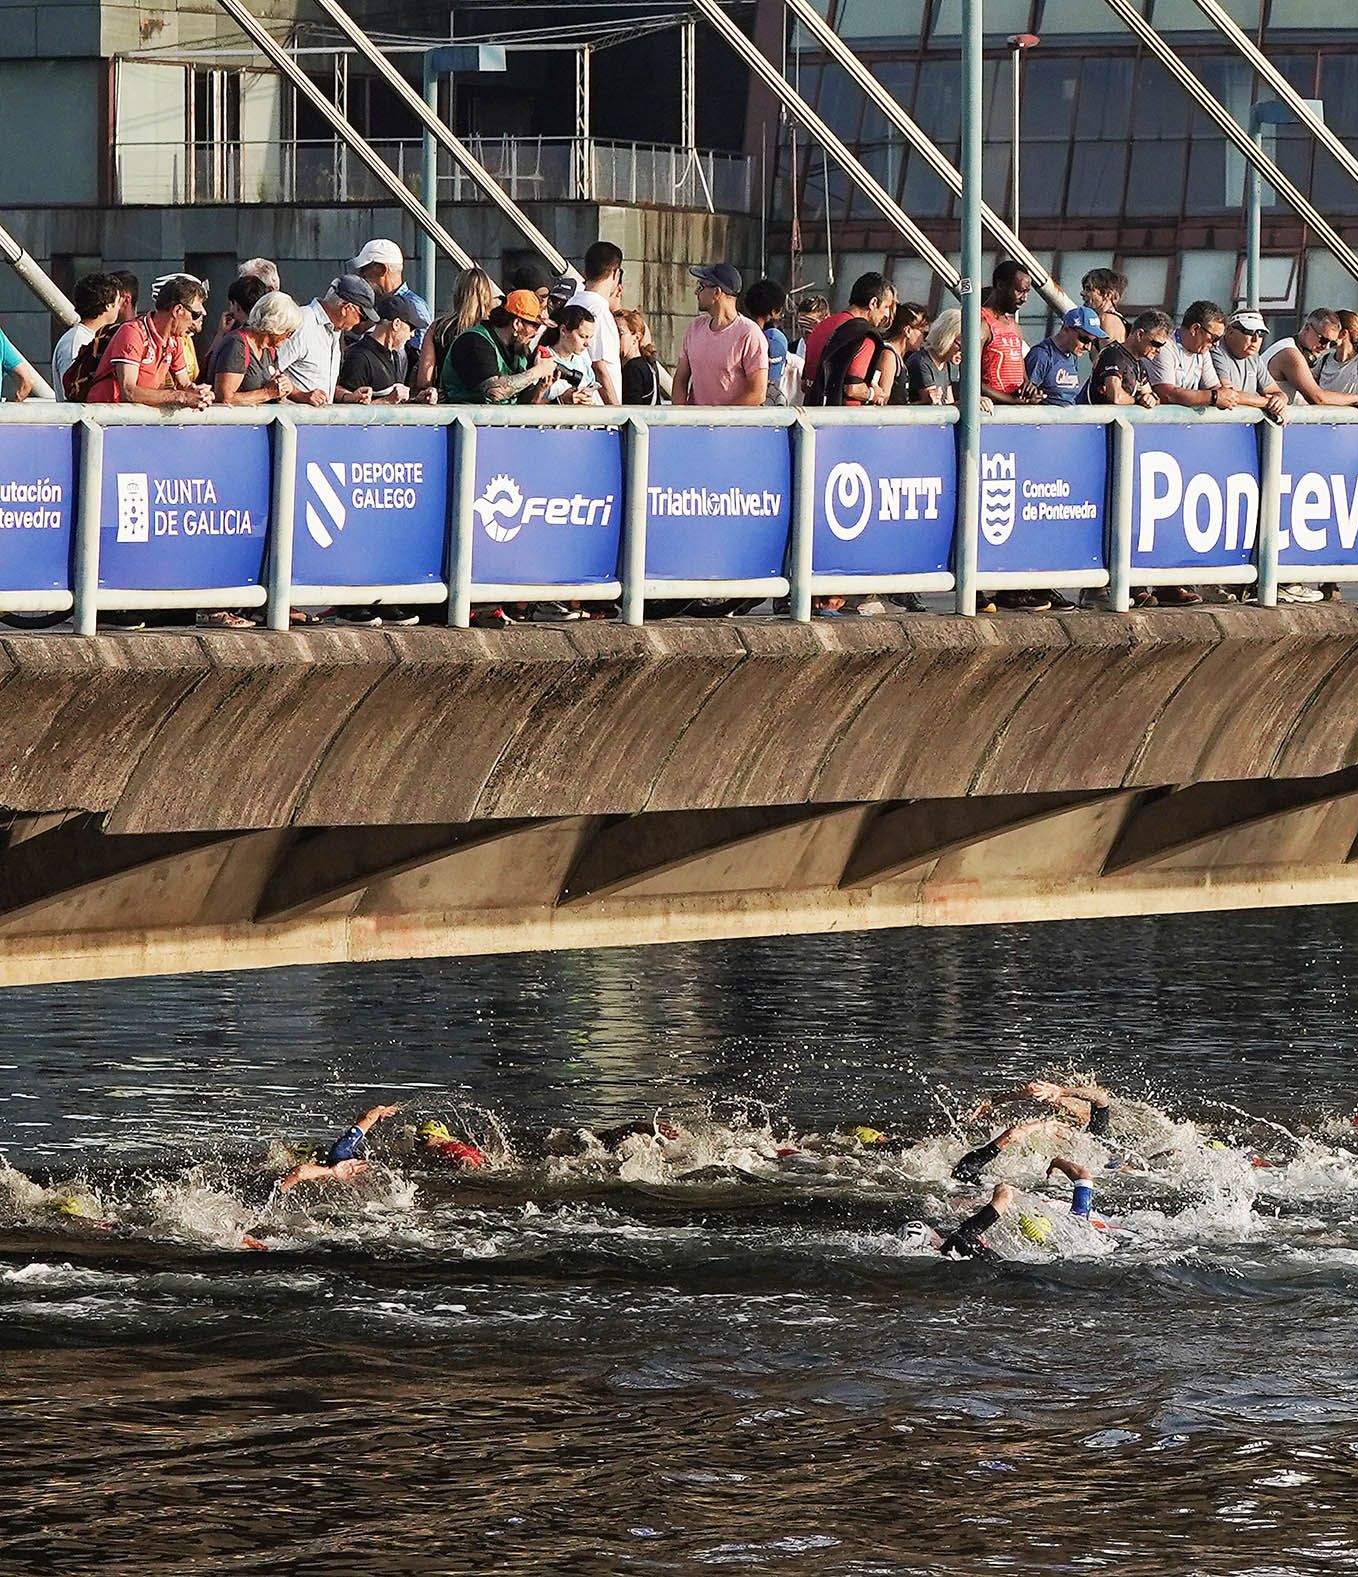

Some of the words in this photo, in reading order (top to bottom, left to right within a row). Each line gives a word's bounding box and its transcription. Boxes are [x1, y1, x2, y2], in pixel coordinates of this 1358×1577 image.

[351, 462, 423, 484] DEPORTE
[154, 479, 217, 504] XUNTA
[352, 488, 416, 509] GALEGO
[878, 476, 942, 521] NTT
[1022, 479, 1070, 498] Concello
[647, 486, 781, 517] Triathlonlive.tv
[1022, 503, 1037, 520] de
[1039, 500, 1097, 520] Pontevedra
[155, 511, 179, 536] DE
[183, 510, 252, 536] GALICIA
